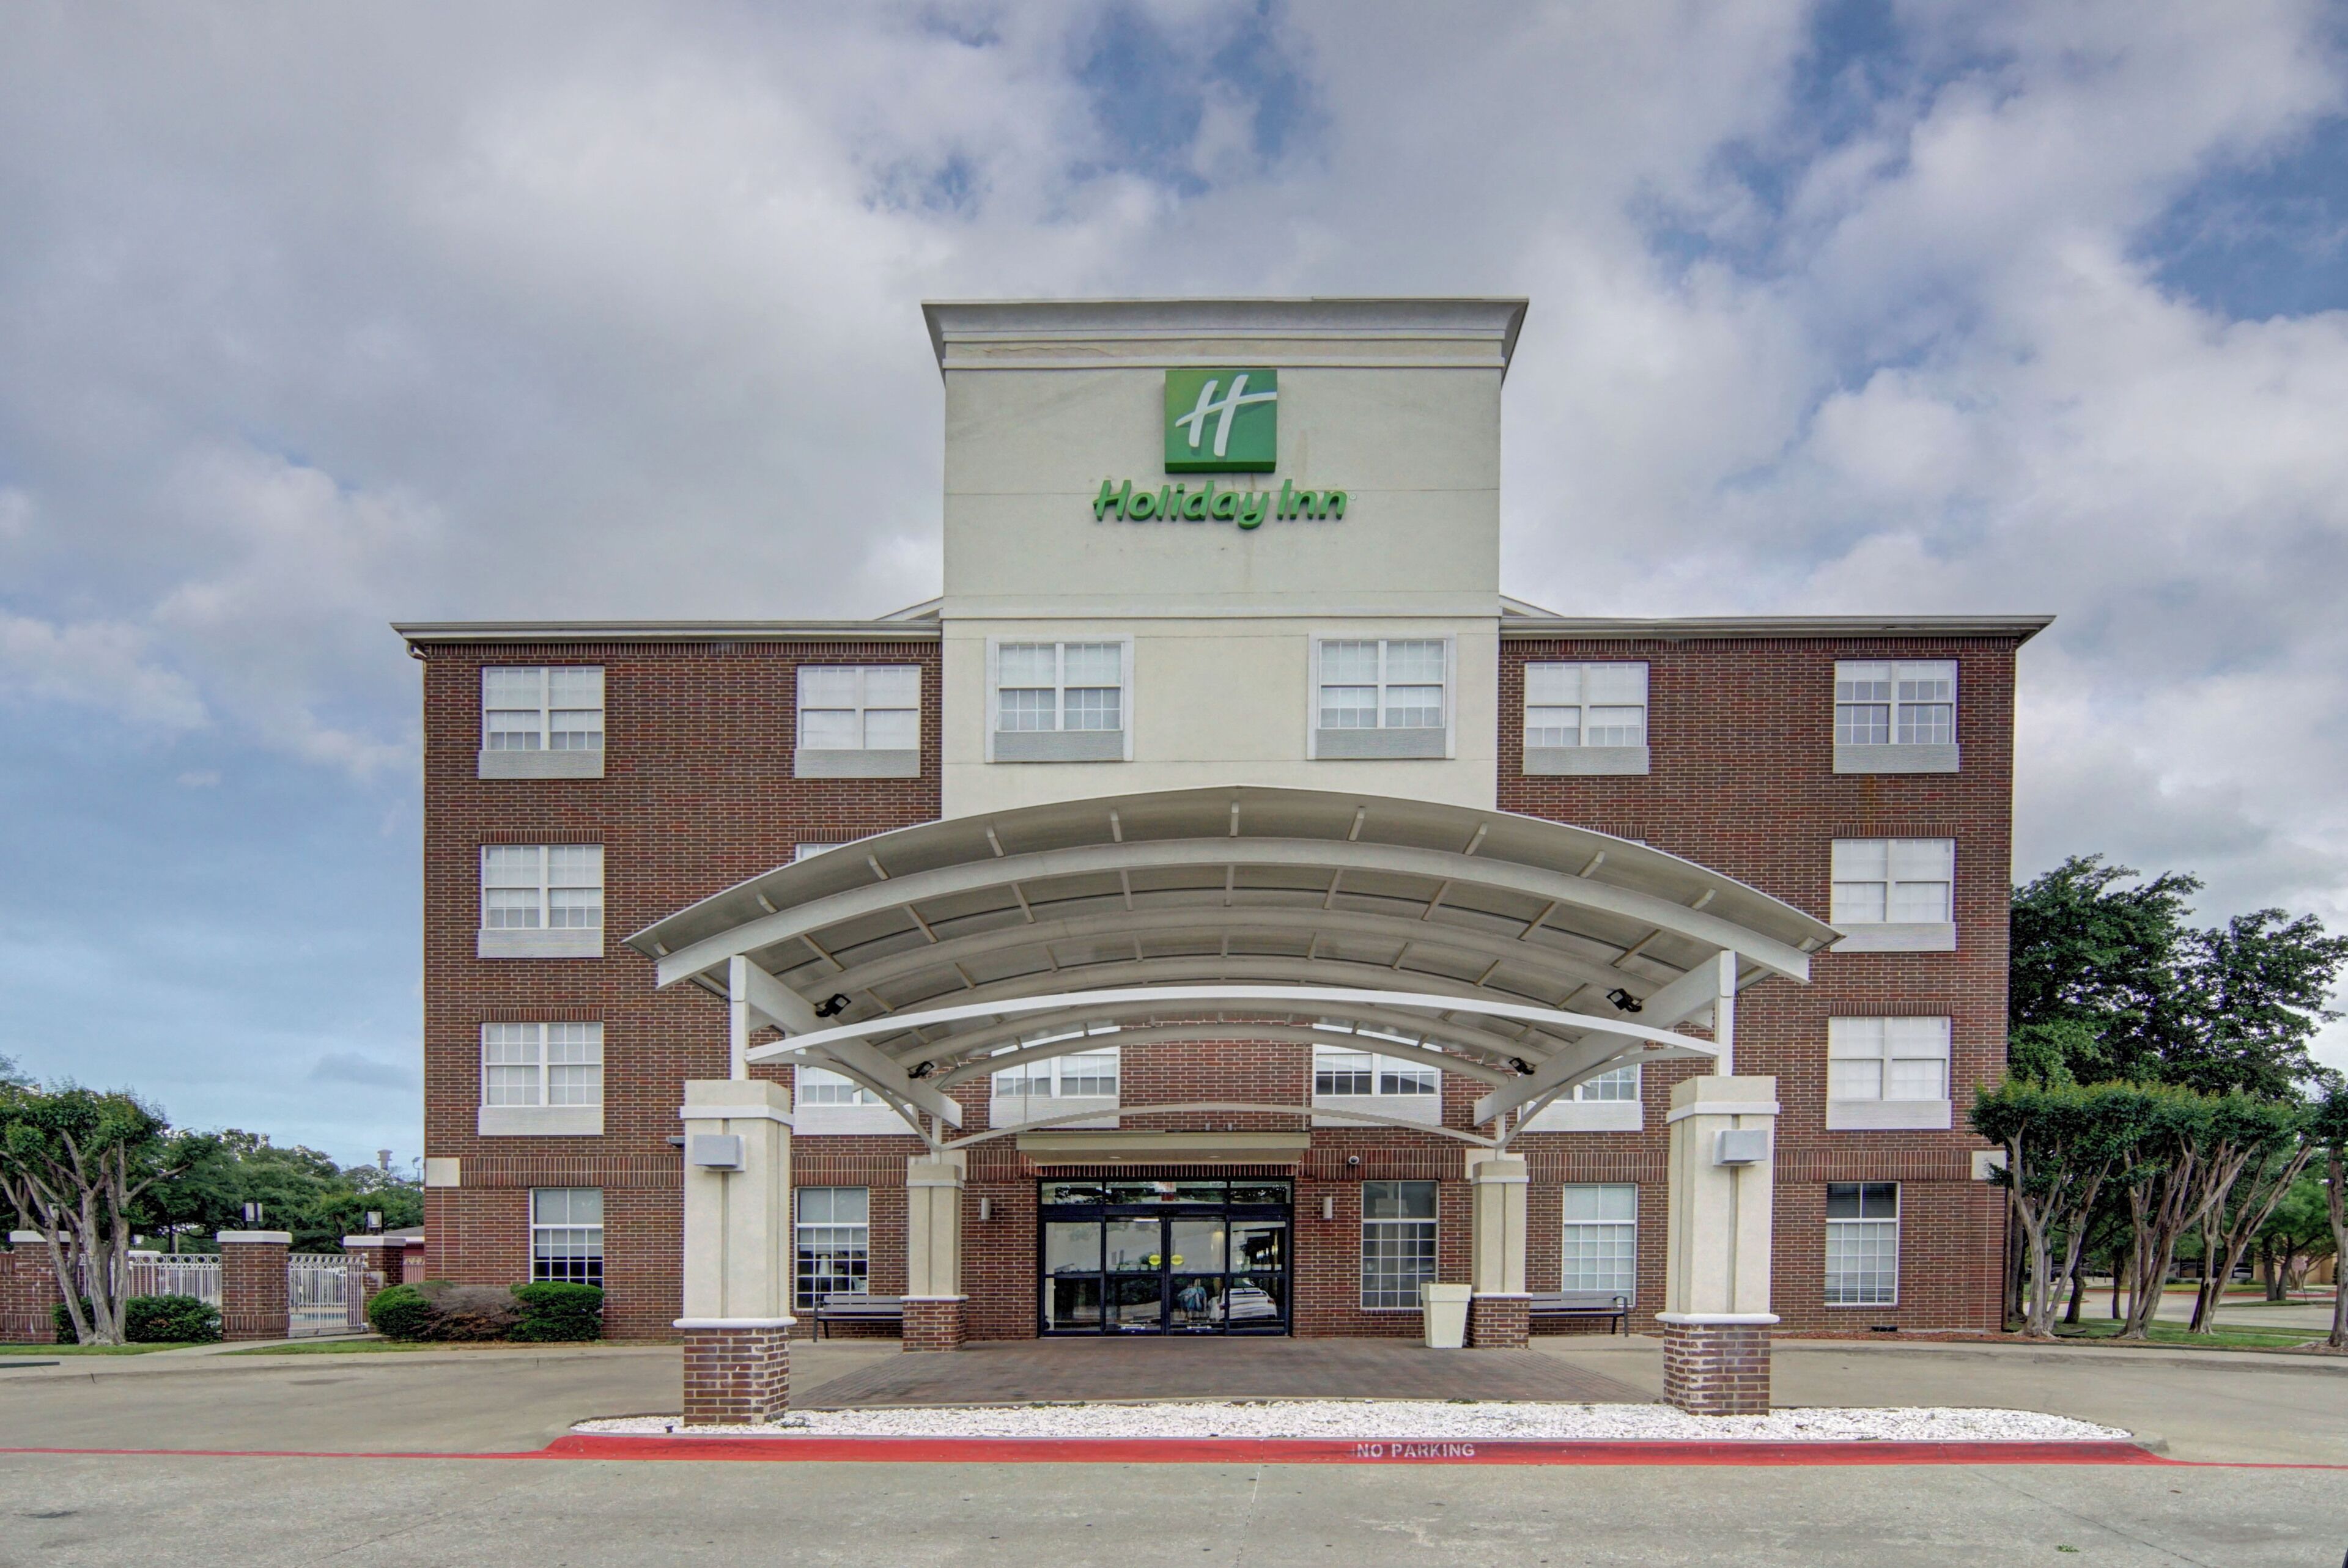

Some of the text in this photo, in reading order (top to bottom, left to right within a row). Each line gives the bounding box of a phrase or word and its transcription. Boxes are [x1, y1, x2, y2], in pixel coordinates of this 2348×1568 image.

[1093, 479, 1348, 529] Holiday Inn
[1357, 1443, 1475, 1457] NO PARKING
